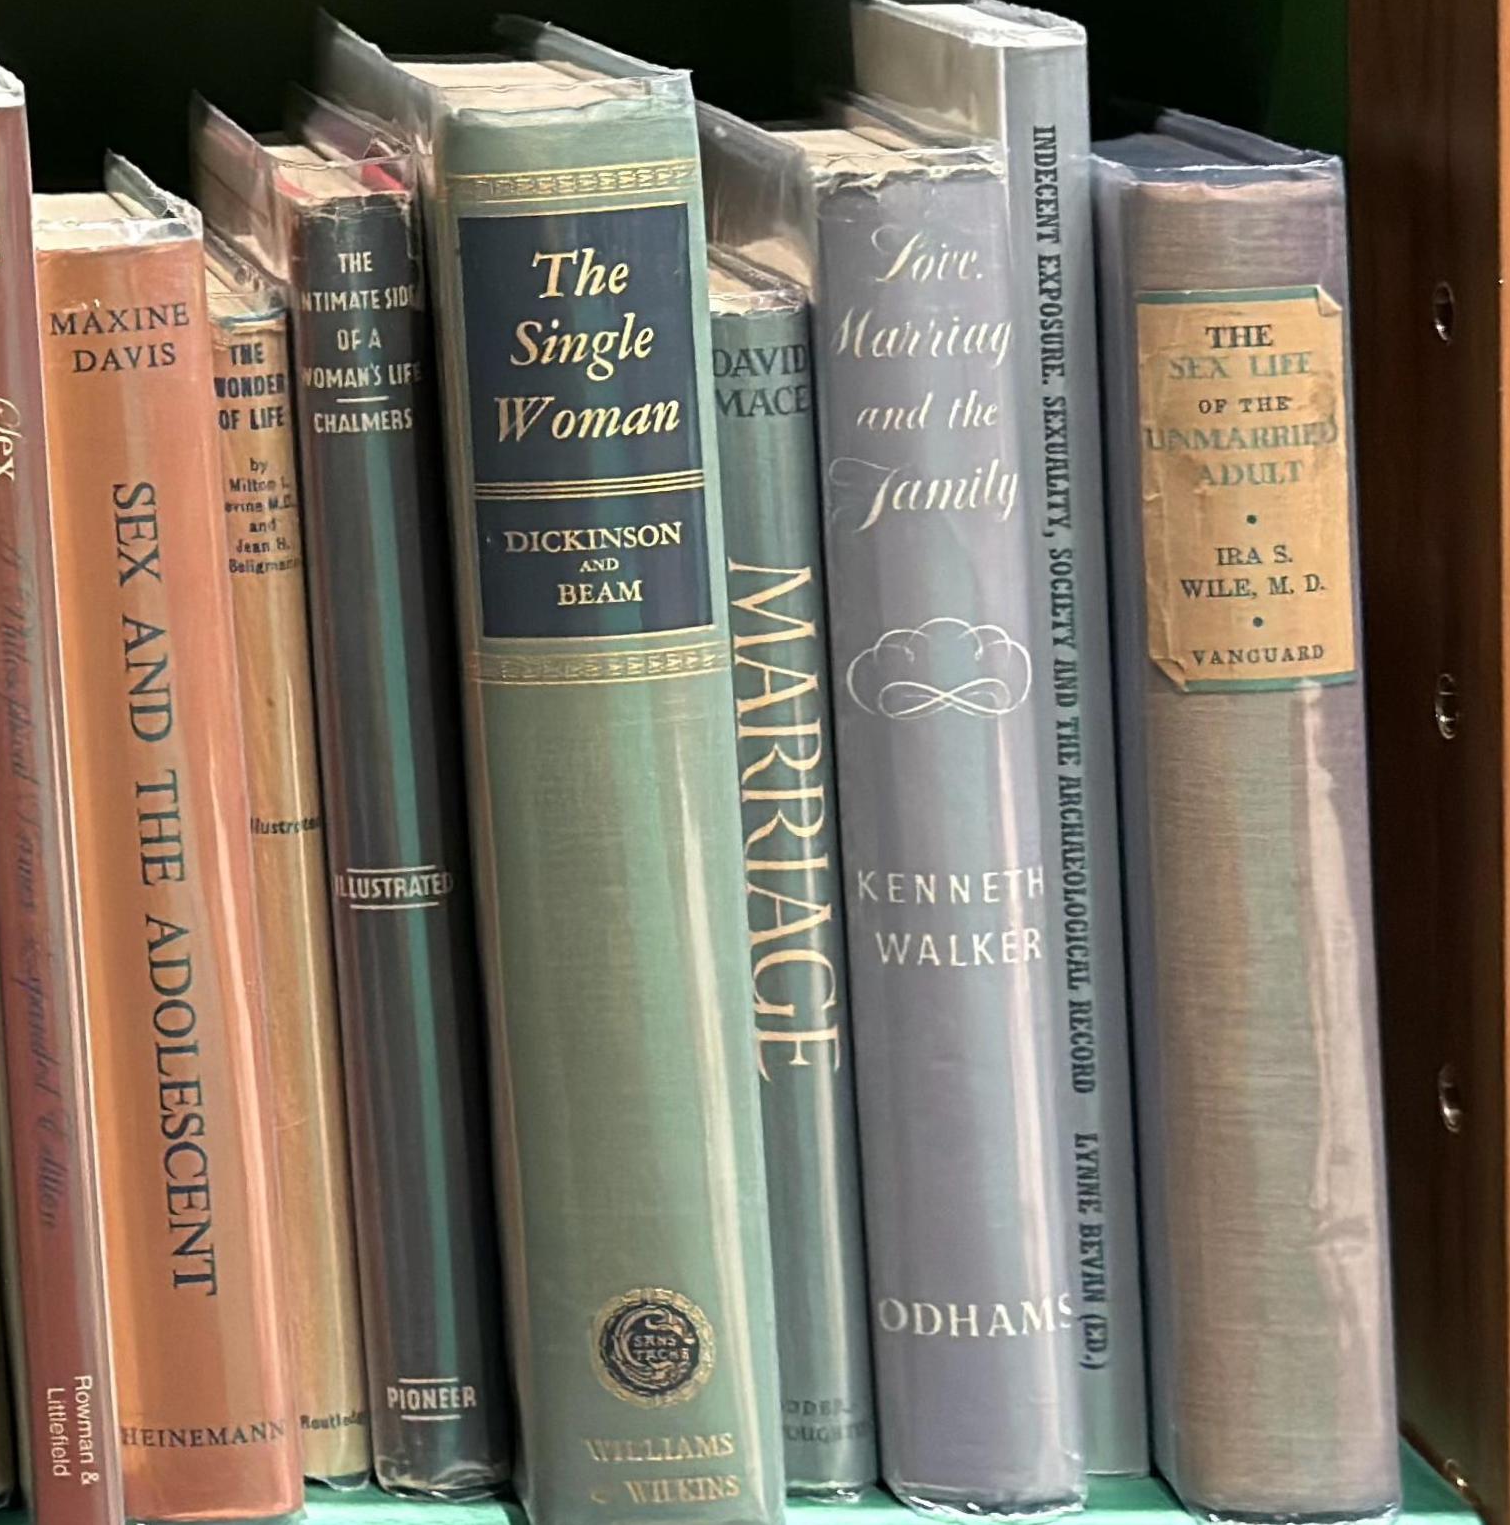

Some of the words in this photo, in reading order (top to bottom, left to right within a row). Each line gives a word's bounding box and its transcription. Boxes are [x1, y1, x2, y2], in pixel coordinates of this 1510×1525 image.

[1033, 124, 1062, 245] INDECENT
[338, 251, 373, 273] THE
[532, 246, 629, 300] The
[48, 302, 191, 337] MAXINE
[337, 328, 361, 351] OF
[510, 311, 655, 383] Single
[1205, 324, 1274, 349] THE
[72, 342, 176, 375] DAVIS
[231, 344, 265, 366] THE
[1169, 355, 1231, 381] SEX
[1249, 351, 1313, 378] LIFE
[214, 376, 285, 400] WONDER
[218, 410, 241, 431] OF
[250, 407, 285, 431] LIFE
[314, 408, 413, 434] CHALMERS
[494, 395, 681, 445] Woman
[856, 390, 935, 433] and
[1198, 398, 1228, 415] OF
[1239, 395, 1291, 412] THE
[249, 457, 268, 474] by
[1195, 459, 1304, 487] ADULT
[112, 481, 163, 588] SEX
[504, 520, 683, 554] DICKINSON
[580, 556, 620, 572] AND
[1215, 546, 1263, 566] IRA
[1273, 545, 1294, 563] S.
[557, 579, 644, 607] BEAM
[1049, 547, 1079, 652] SOCIETY
[1191, 644, 1325, 666] VANGUARD
[120, 612, 175, 744] AND
[1055, 716, 1083, 768] THE
[135, 768, 188, 887] THE
[726, 557, 842, 1083] MARRIAGE
[334, 872, 453, 899] ILLUSTRATED
[857, 865, 1046, 906] KENNETH
[874, 927, 1044, 969] WALKER
[1067, 998, 1098, 1095] RECORD
[143, 912, 219, 1297] ADOLESCENT
[1073, 1131, 1103, 1214] LYNNE
[1079, 1222, 1108, 1303] BEVAN
[386, 1384, 477, 1411] PIONEER
[47, 1386, 72, 1478] Littlefield
[73, 1374, 94, 1465] Rowman
[121, 1420, 286, 1449] HEINEMANN
[584, 1432, 736, 1462] WILLIAMS
[80, 1471, 99, 1486] &
[624, 1475, 742, 1505] WILKINS
